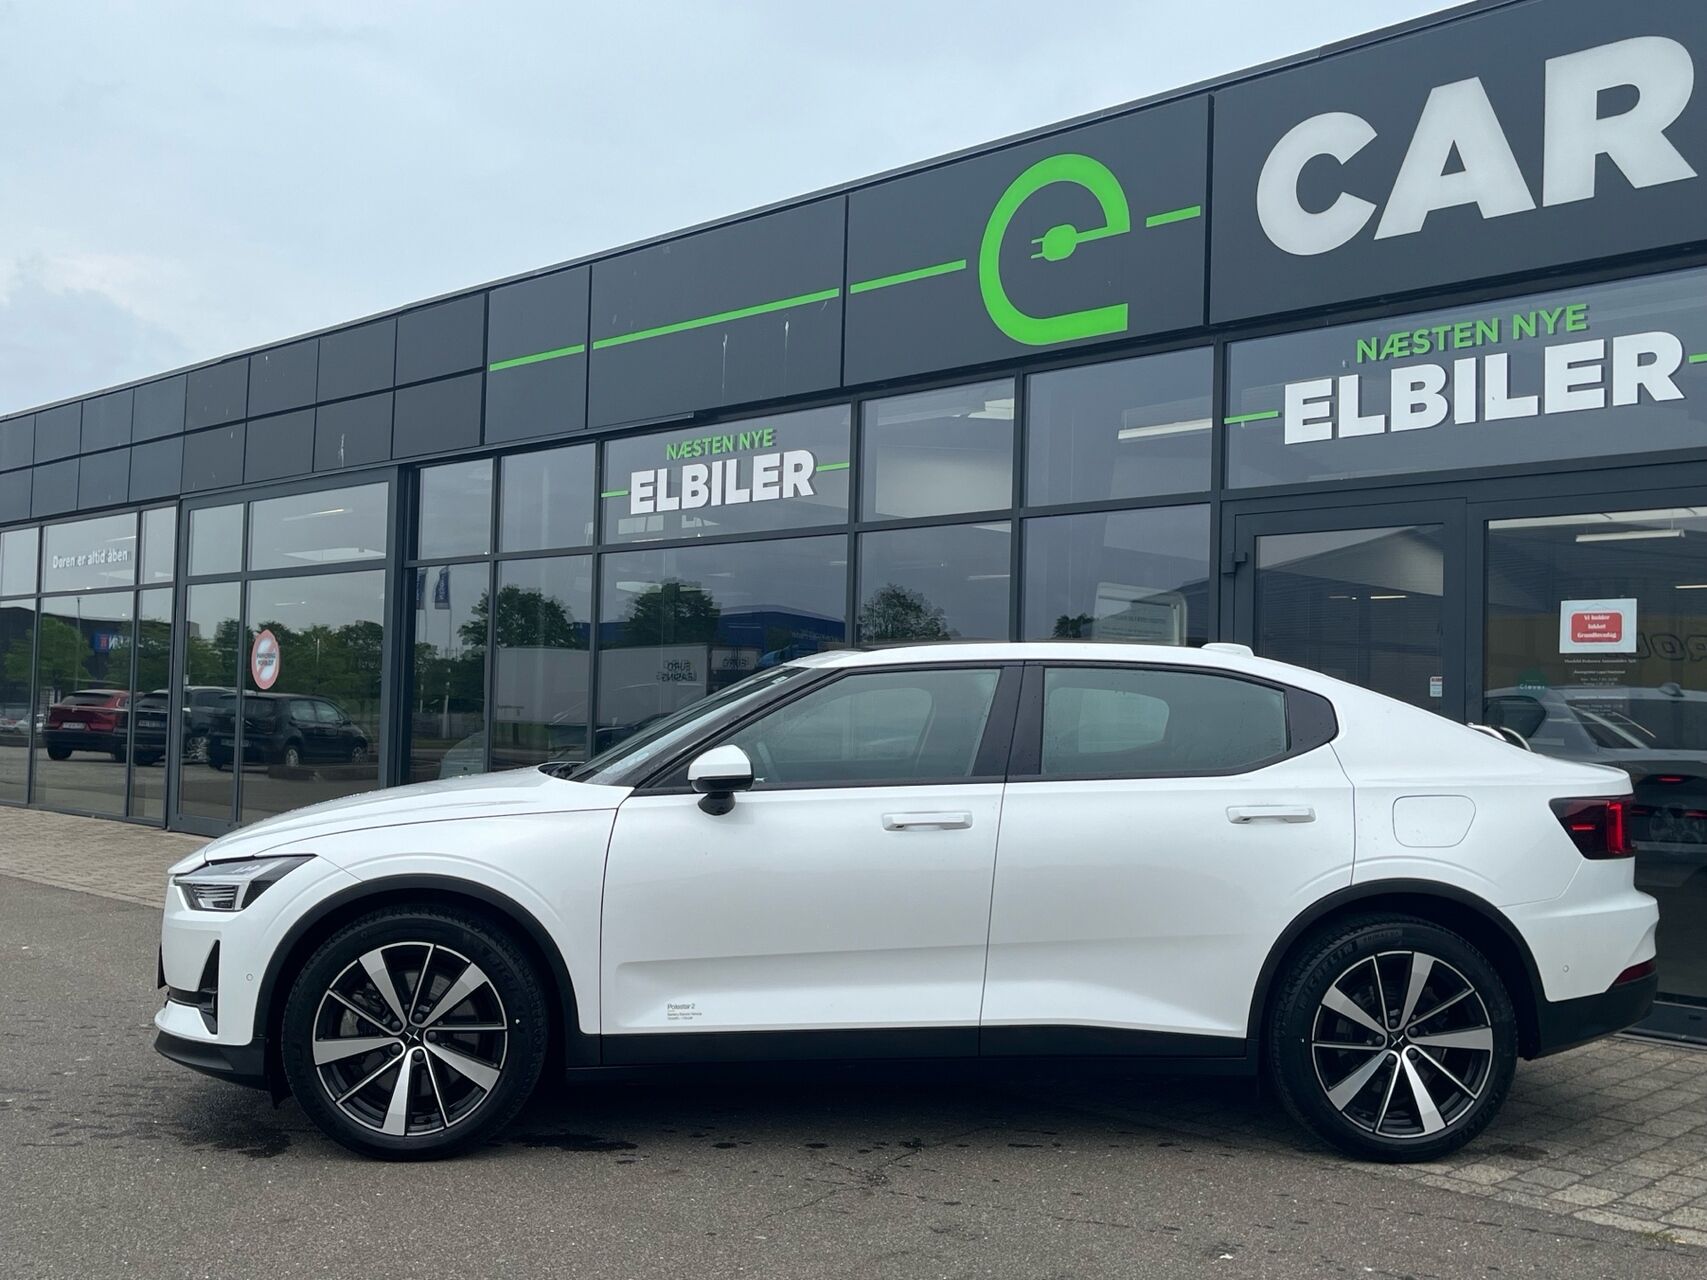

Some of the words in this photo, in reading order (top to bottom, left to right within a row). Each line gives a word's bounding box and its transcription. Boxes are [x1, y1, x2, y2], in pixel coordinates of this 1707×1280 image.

[1256, 35, 1698, 256] CAR
[1357, 318, 1499, 363] NÆSTEN
[1512, 303, 1588, 340] NYE
[1284, 331, 1686, 445] ELBILER
[667, 434, 734, 460] NÆSTEN
[739, 428, 774, 450] NYE
[630, 449, 815, 514] ELBILER
[78, 555, 86, 566] er
[88, 549, 105, 565] altid
